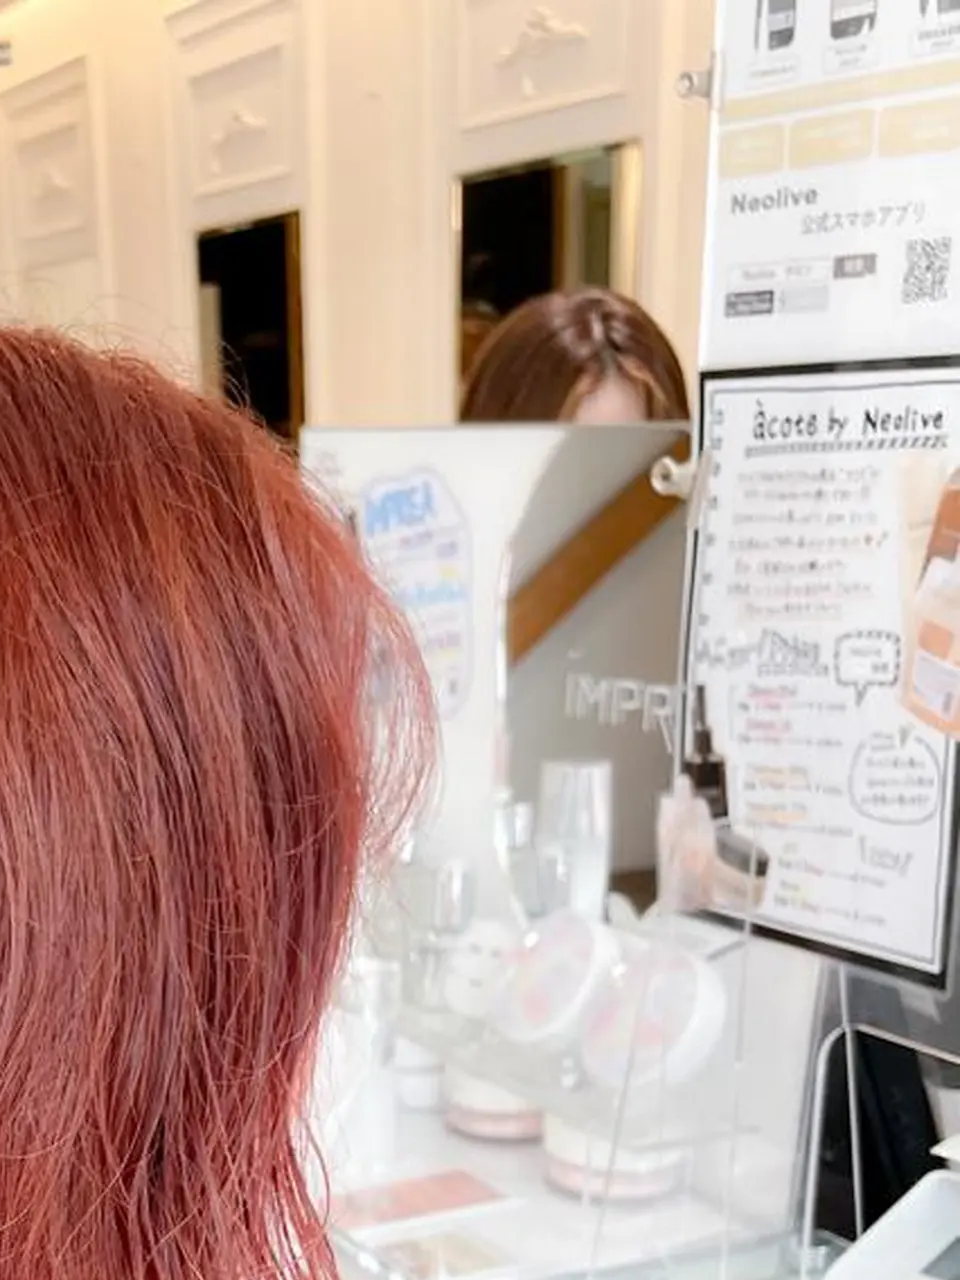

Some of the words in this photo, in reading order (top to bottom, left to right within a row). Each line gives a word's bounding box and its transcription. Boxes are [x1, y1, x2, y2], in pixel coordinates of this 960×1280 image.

[730, 187, 818, 215] Neolive
[827, 404, 849, 439] by
[861, 405, 944, 436] Neolive
